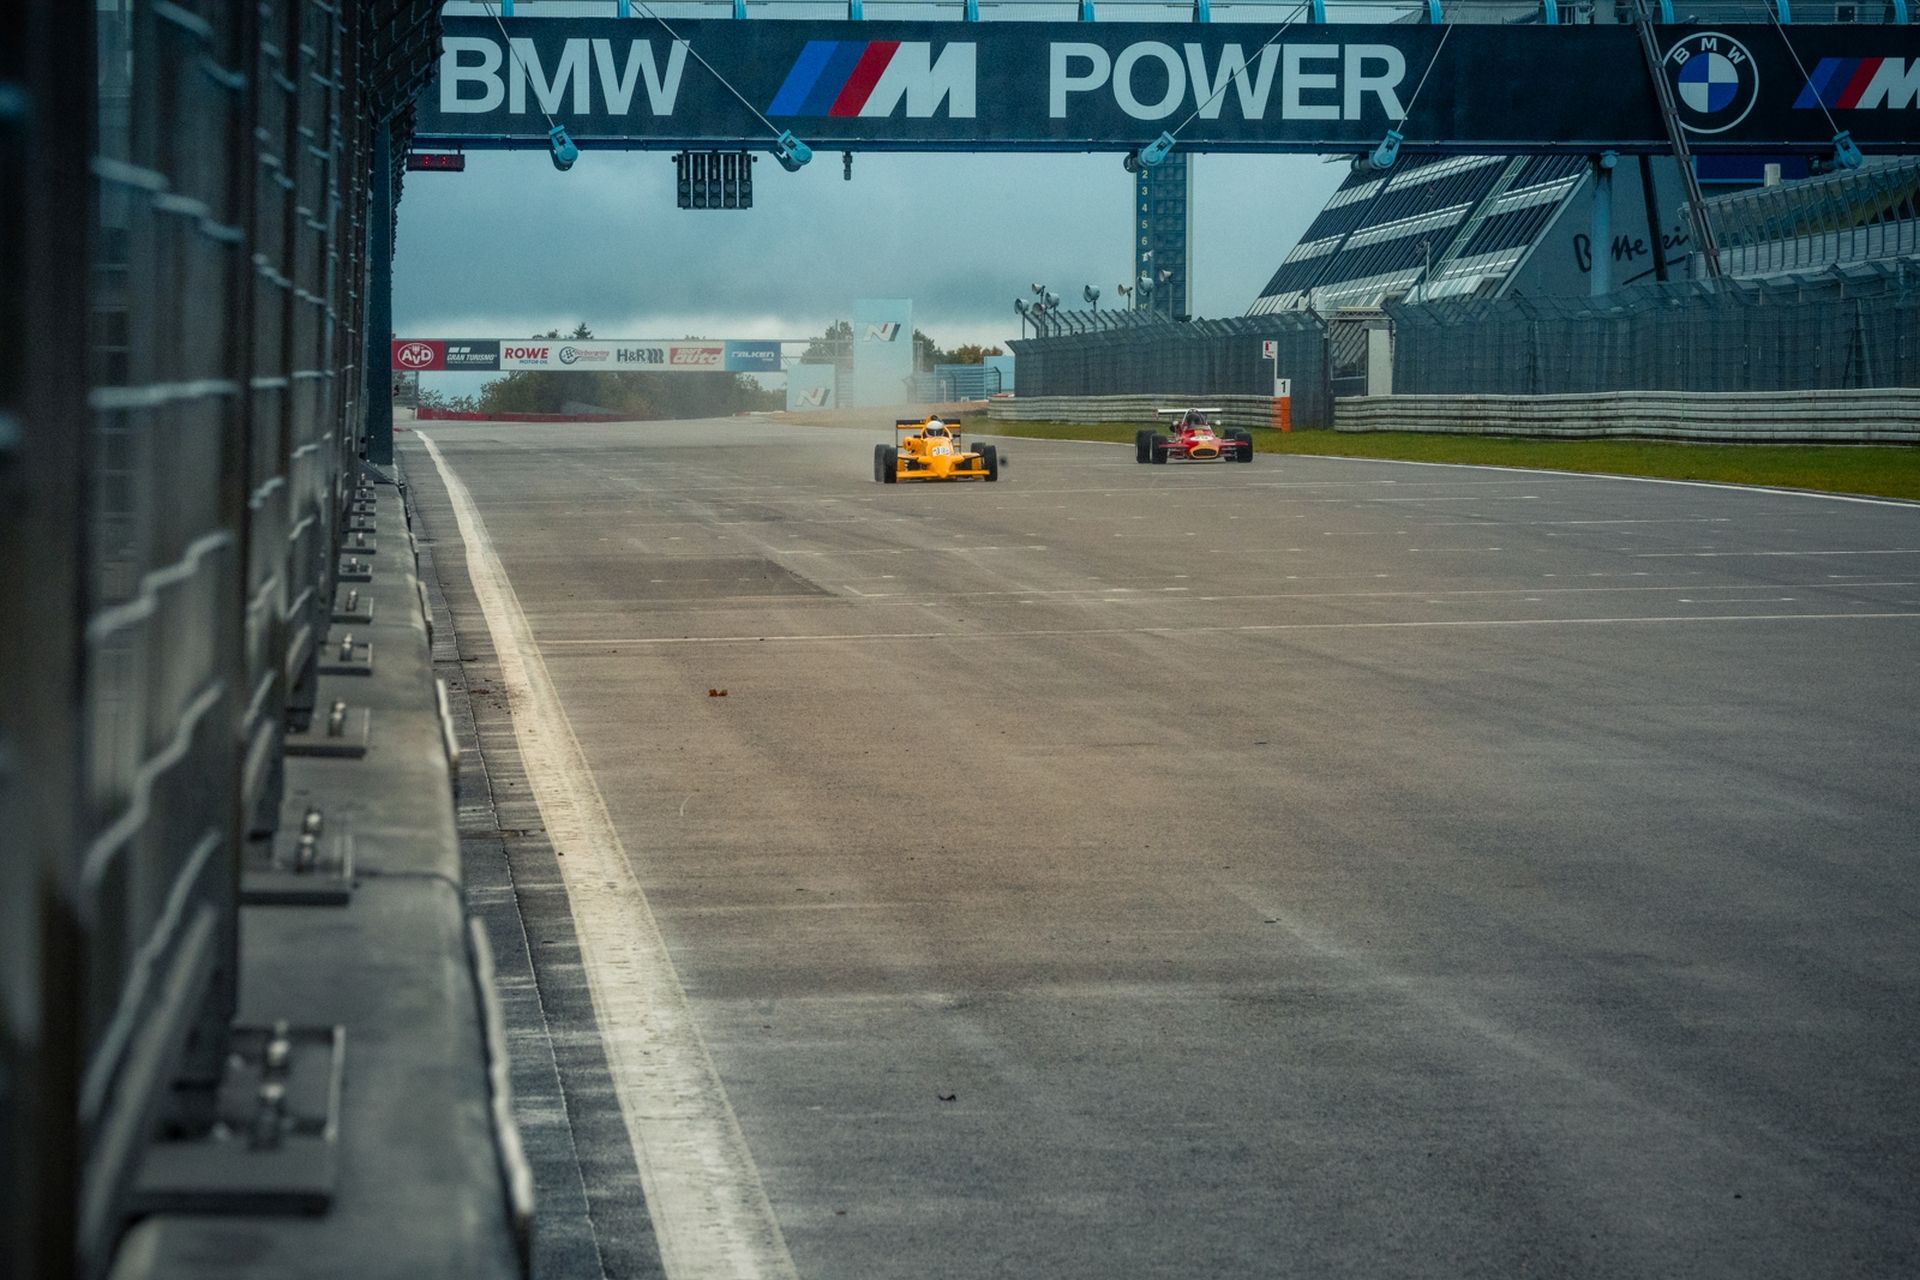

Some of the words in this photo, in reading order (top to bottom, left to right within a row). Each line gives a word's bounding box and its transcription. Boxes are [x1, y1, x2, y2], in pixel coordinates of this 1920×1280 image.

[1672, 37, 1747, 65] BMW
[440, 36, 690, 116] BMW
[858, 41, 977, 118] M
[1049, 41, 1408, 122] POWER
[1141, 170, 1149, 179] 2
[1141, 186, 1148, 196] 3
[1141, 203, 1148, 213] 4
[1141, 220, 1148, 229] 5
[1141, 236, 1148, 246] 6
[504, 347, 549, 359] ROWE
[617, 348, 645, 362] H&R
[673, 353, 722, 364] auto
[1281, 380, 1286, 393] 1
